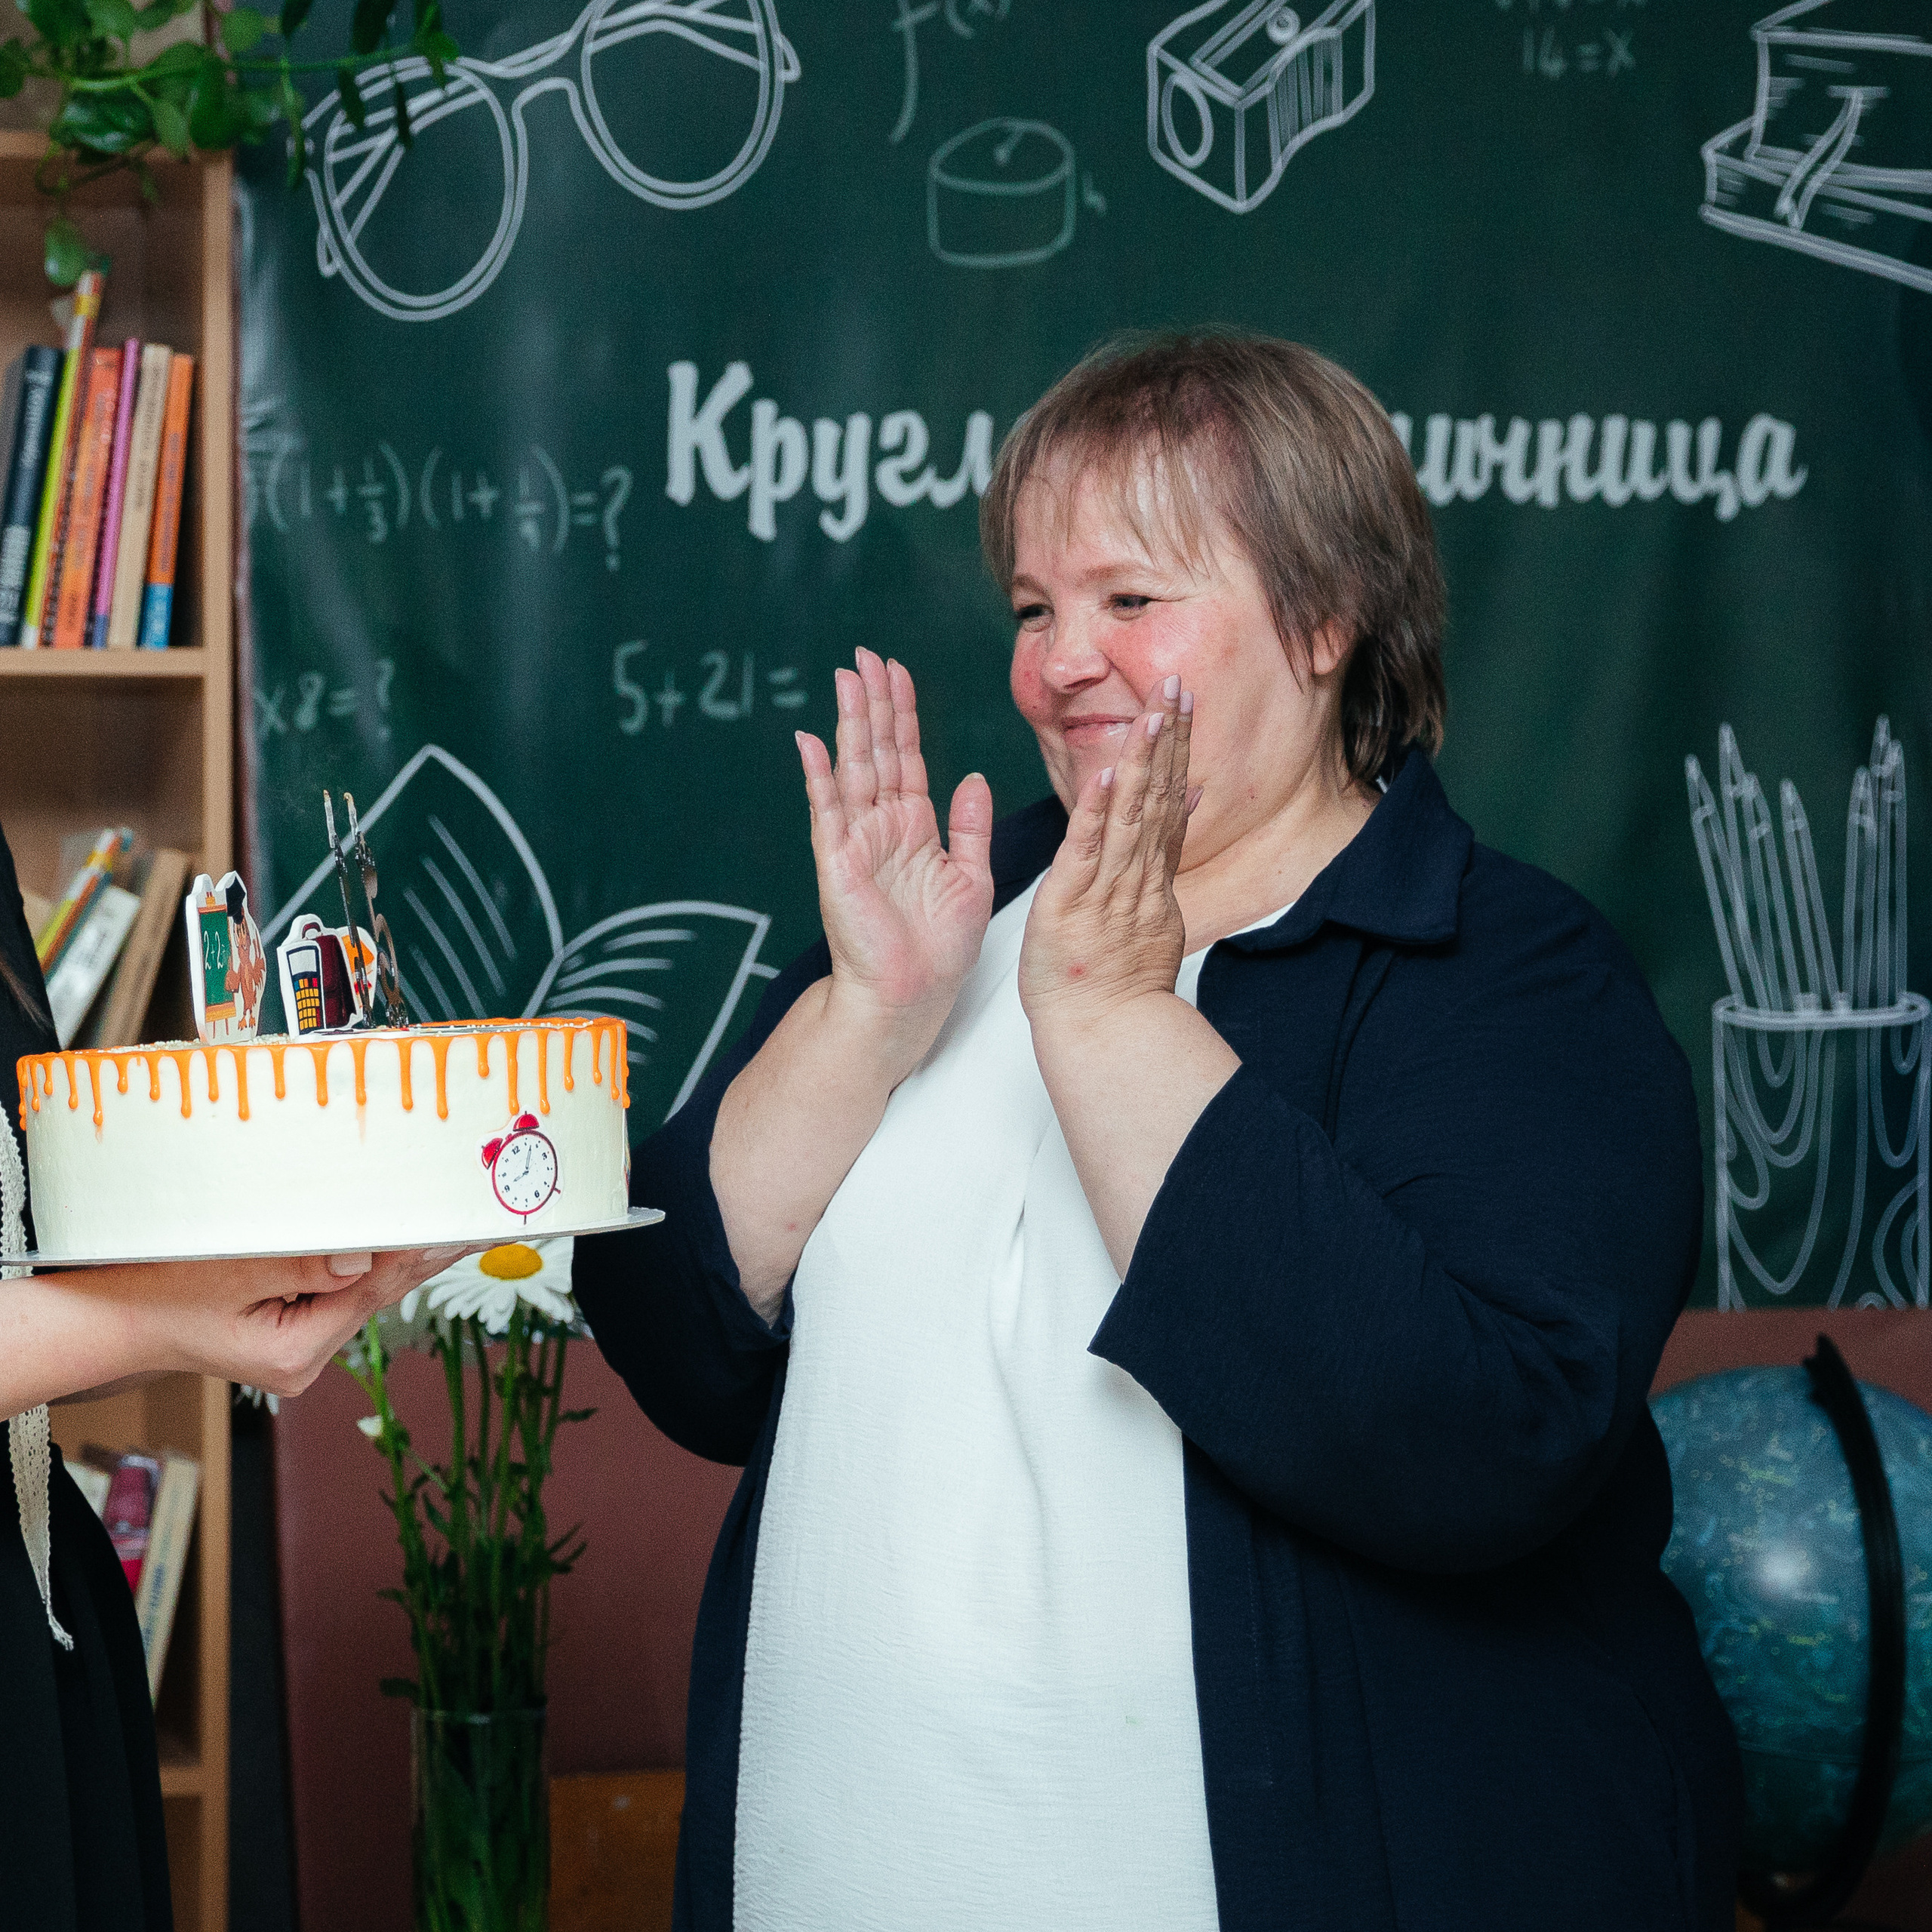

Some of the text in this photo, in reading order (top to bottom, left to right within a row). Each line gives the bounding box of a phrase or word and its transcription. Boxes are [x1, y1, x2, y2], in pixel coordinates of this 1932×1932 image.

[666, 361, 1809, 542] Кругл ичница
[512, 1146, 520, 1155] 12
